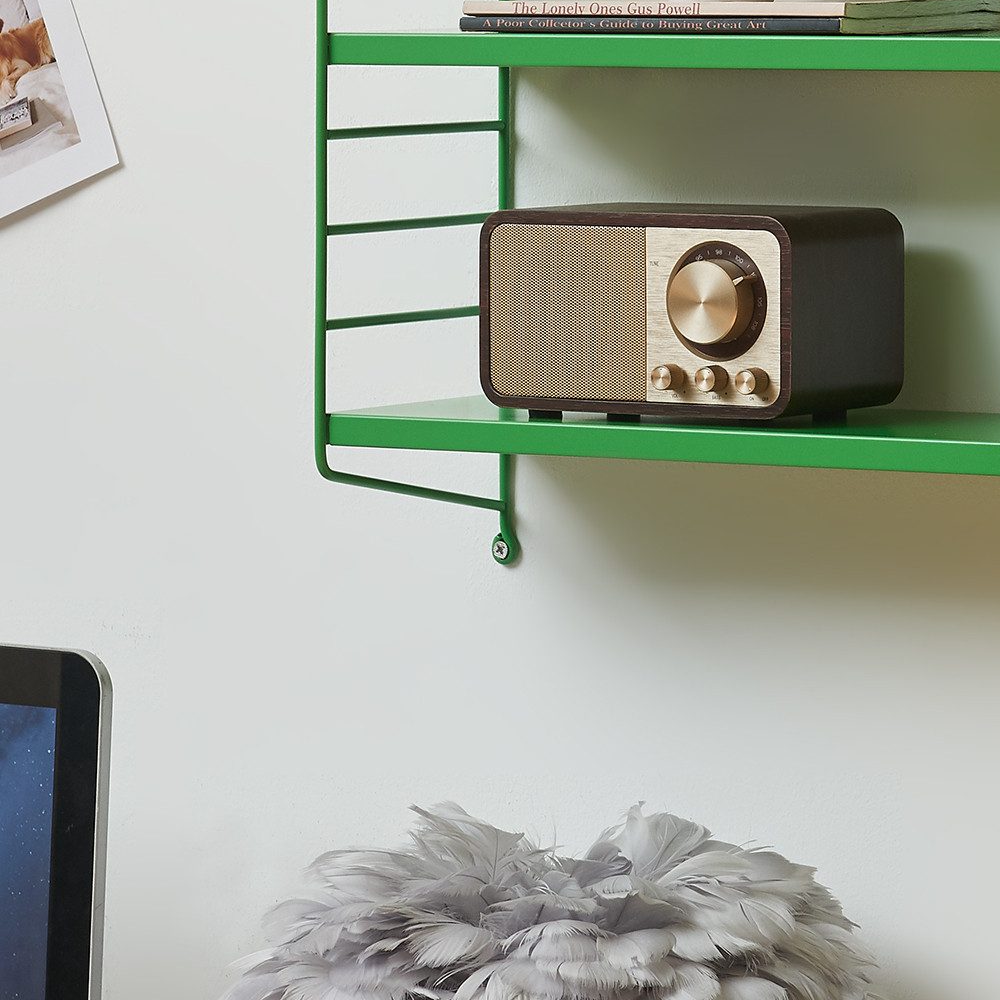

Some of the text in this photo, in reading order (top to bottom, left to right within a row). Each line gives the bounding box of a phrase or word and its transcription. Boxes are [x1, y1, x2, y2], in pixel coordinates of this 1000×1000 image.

[512, 2, 701, 15] The Lonely Ones Gus Powell
[482, 18, 492, 27] A
[496, 18, 525, 28] Poor
[599, 19, 638, 28] Guide
[641, 19, 654, 29] to
[658, 19, 703, 31] Buying
[706, 20, 742, 29] Great
[746, 20, 767, 29] Art
